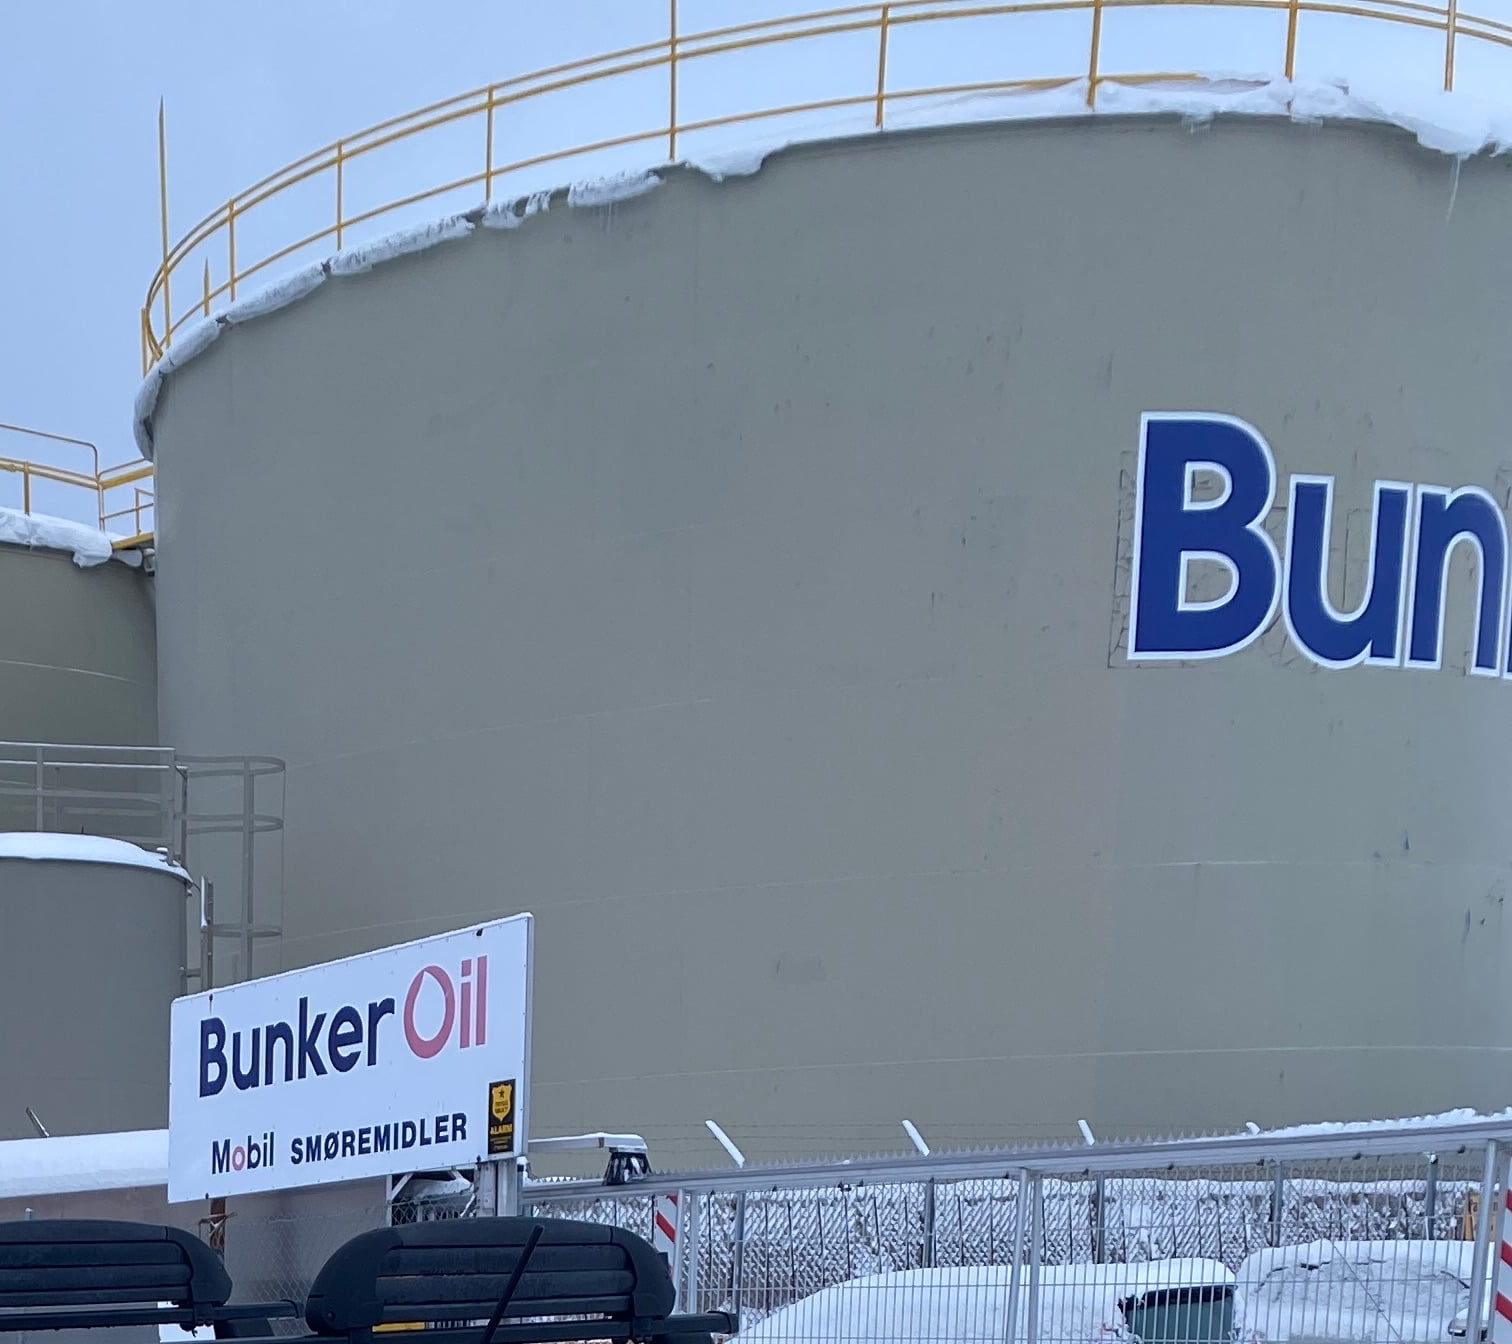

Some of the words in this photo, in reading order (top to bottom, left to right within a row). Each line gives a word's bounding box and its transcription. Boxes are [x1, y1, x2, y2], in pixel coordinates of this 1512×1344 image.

[1129, 412, 1512, 677] Bun
[212, 1132, 274, 1174] Mobil
[291, 1112, 467, 1165] SMØREMIDLER
